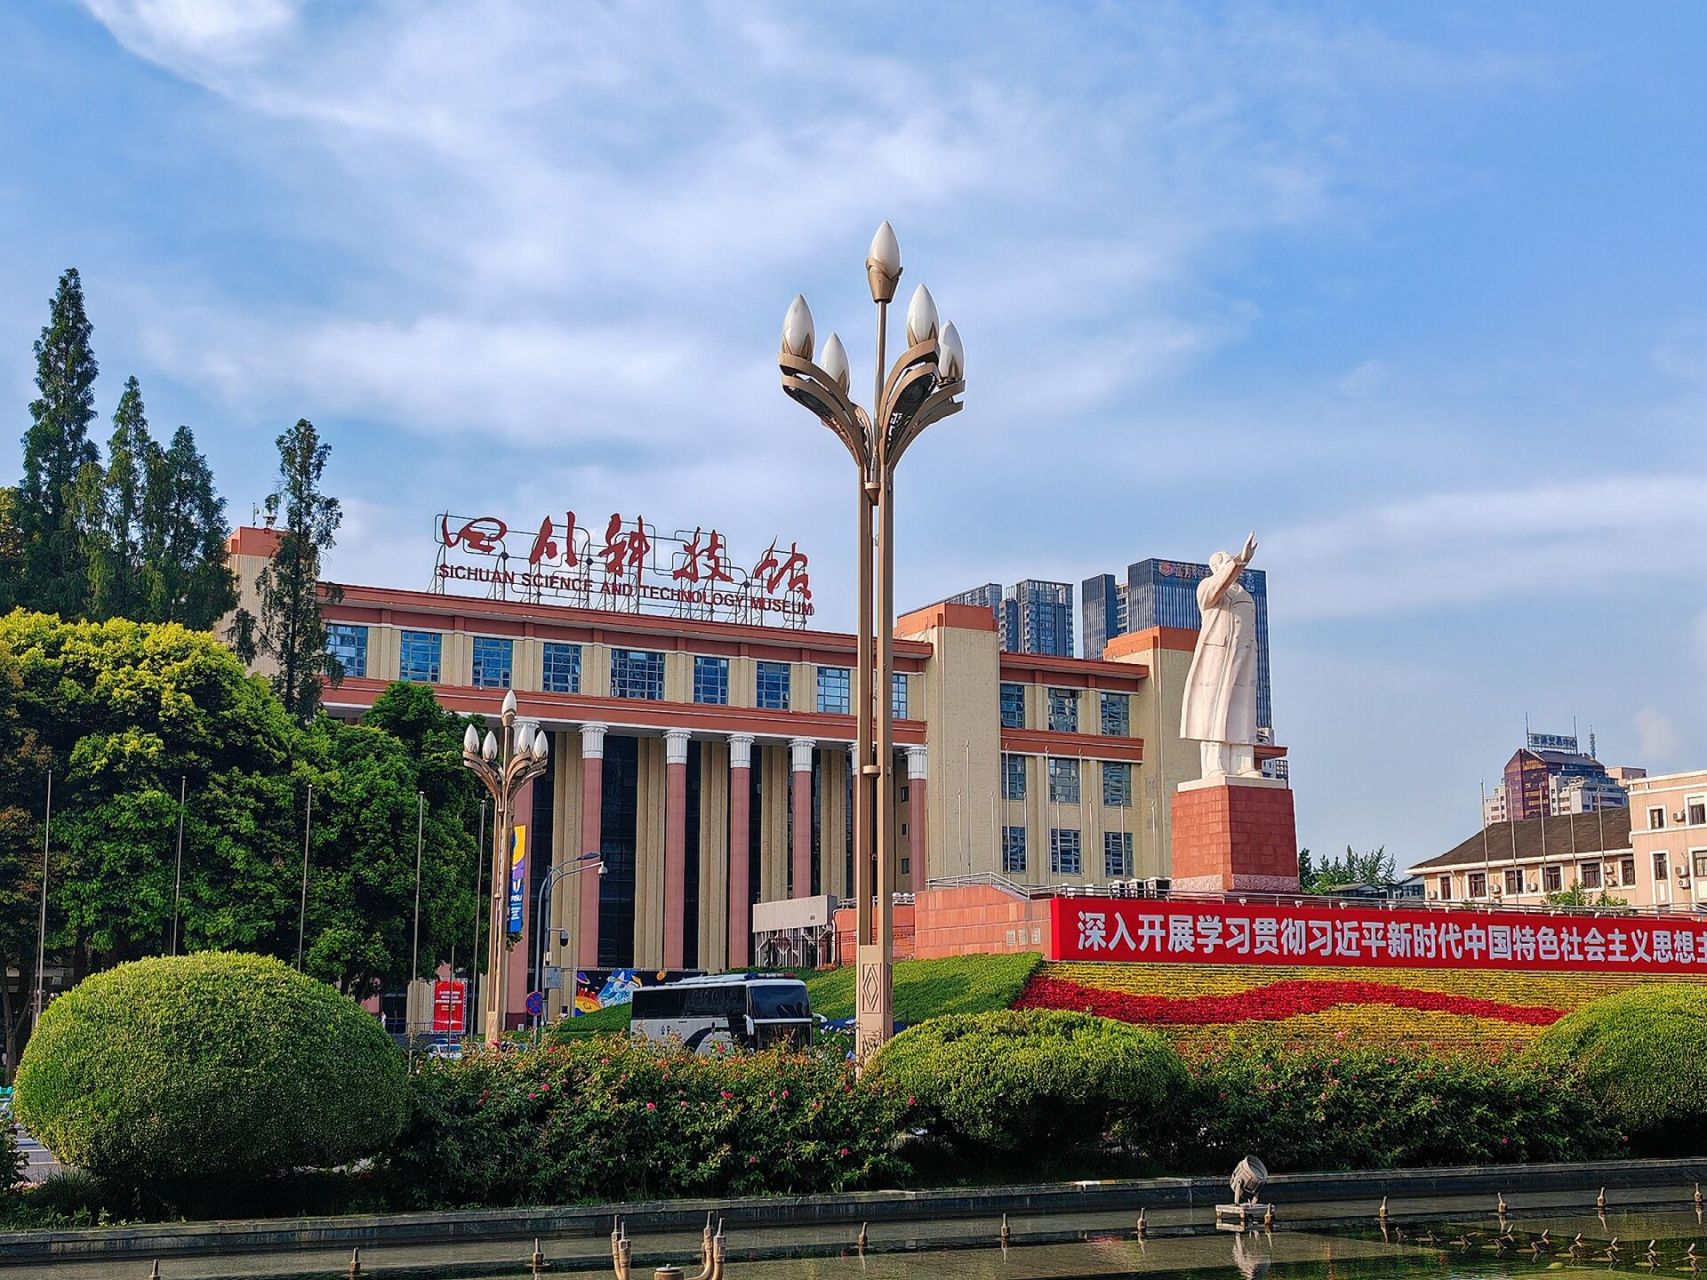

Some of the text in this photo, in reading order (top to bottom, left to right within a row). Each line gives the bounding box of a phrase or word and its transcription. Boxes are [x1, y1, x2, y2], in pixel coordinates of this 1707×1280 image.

[439, 564, 815, 617] SICHUAN SCIENCE AND TECHNOLOGY MUSEUM
